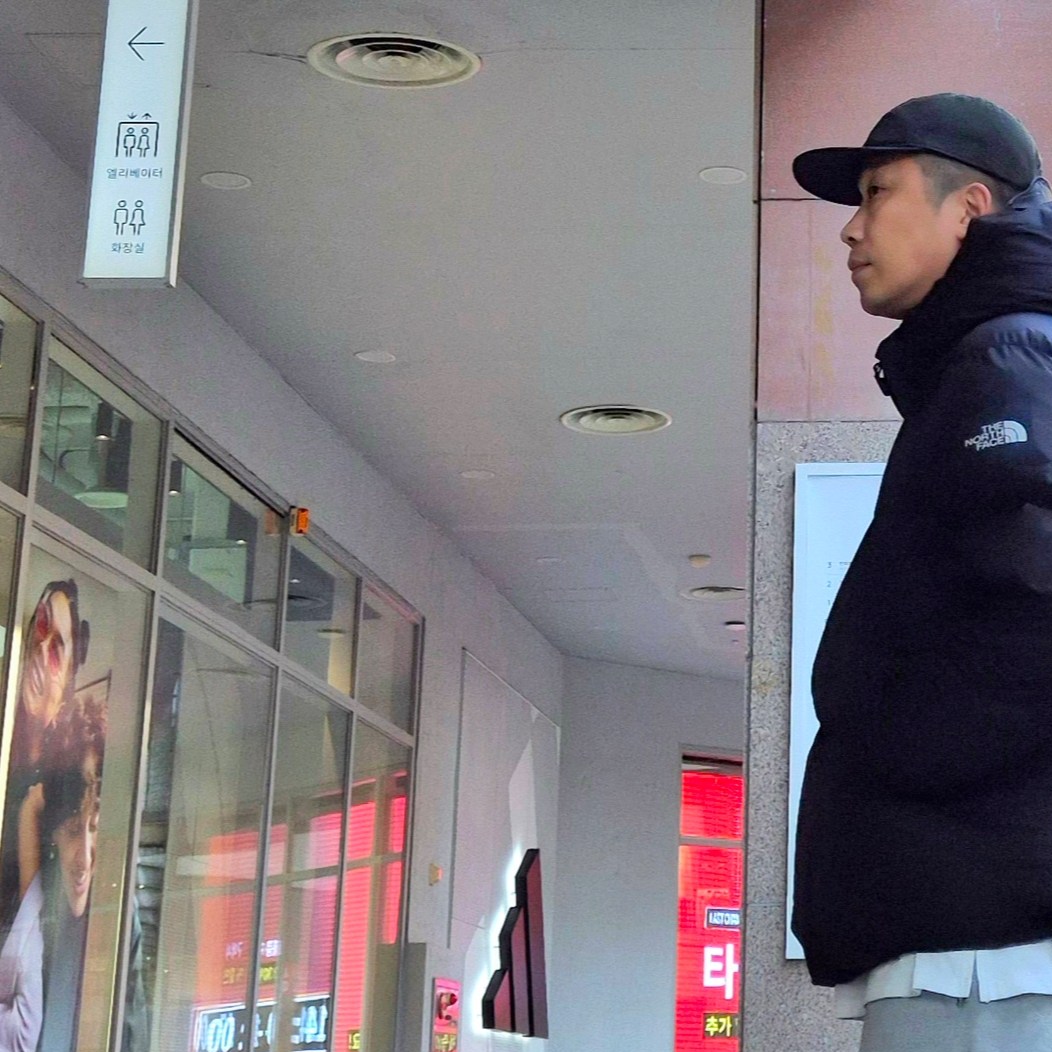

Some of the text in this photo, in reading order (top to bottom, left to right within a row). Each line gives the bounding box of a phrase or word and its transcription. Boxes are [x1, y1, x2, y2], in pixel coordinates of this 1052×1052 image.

[106, 167, 163, 180] 엘리베이터
[111, 242, 145, 254] 화장실
[981, 421, 1004, 433] THE
[964, 431, 1005, 447] NORTH
[976, 437, 1005, 452] FACE
[705, 1015, 733, 1038] 추가
